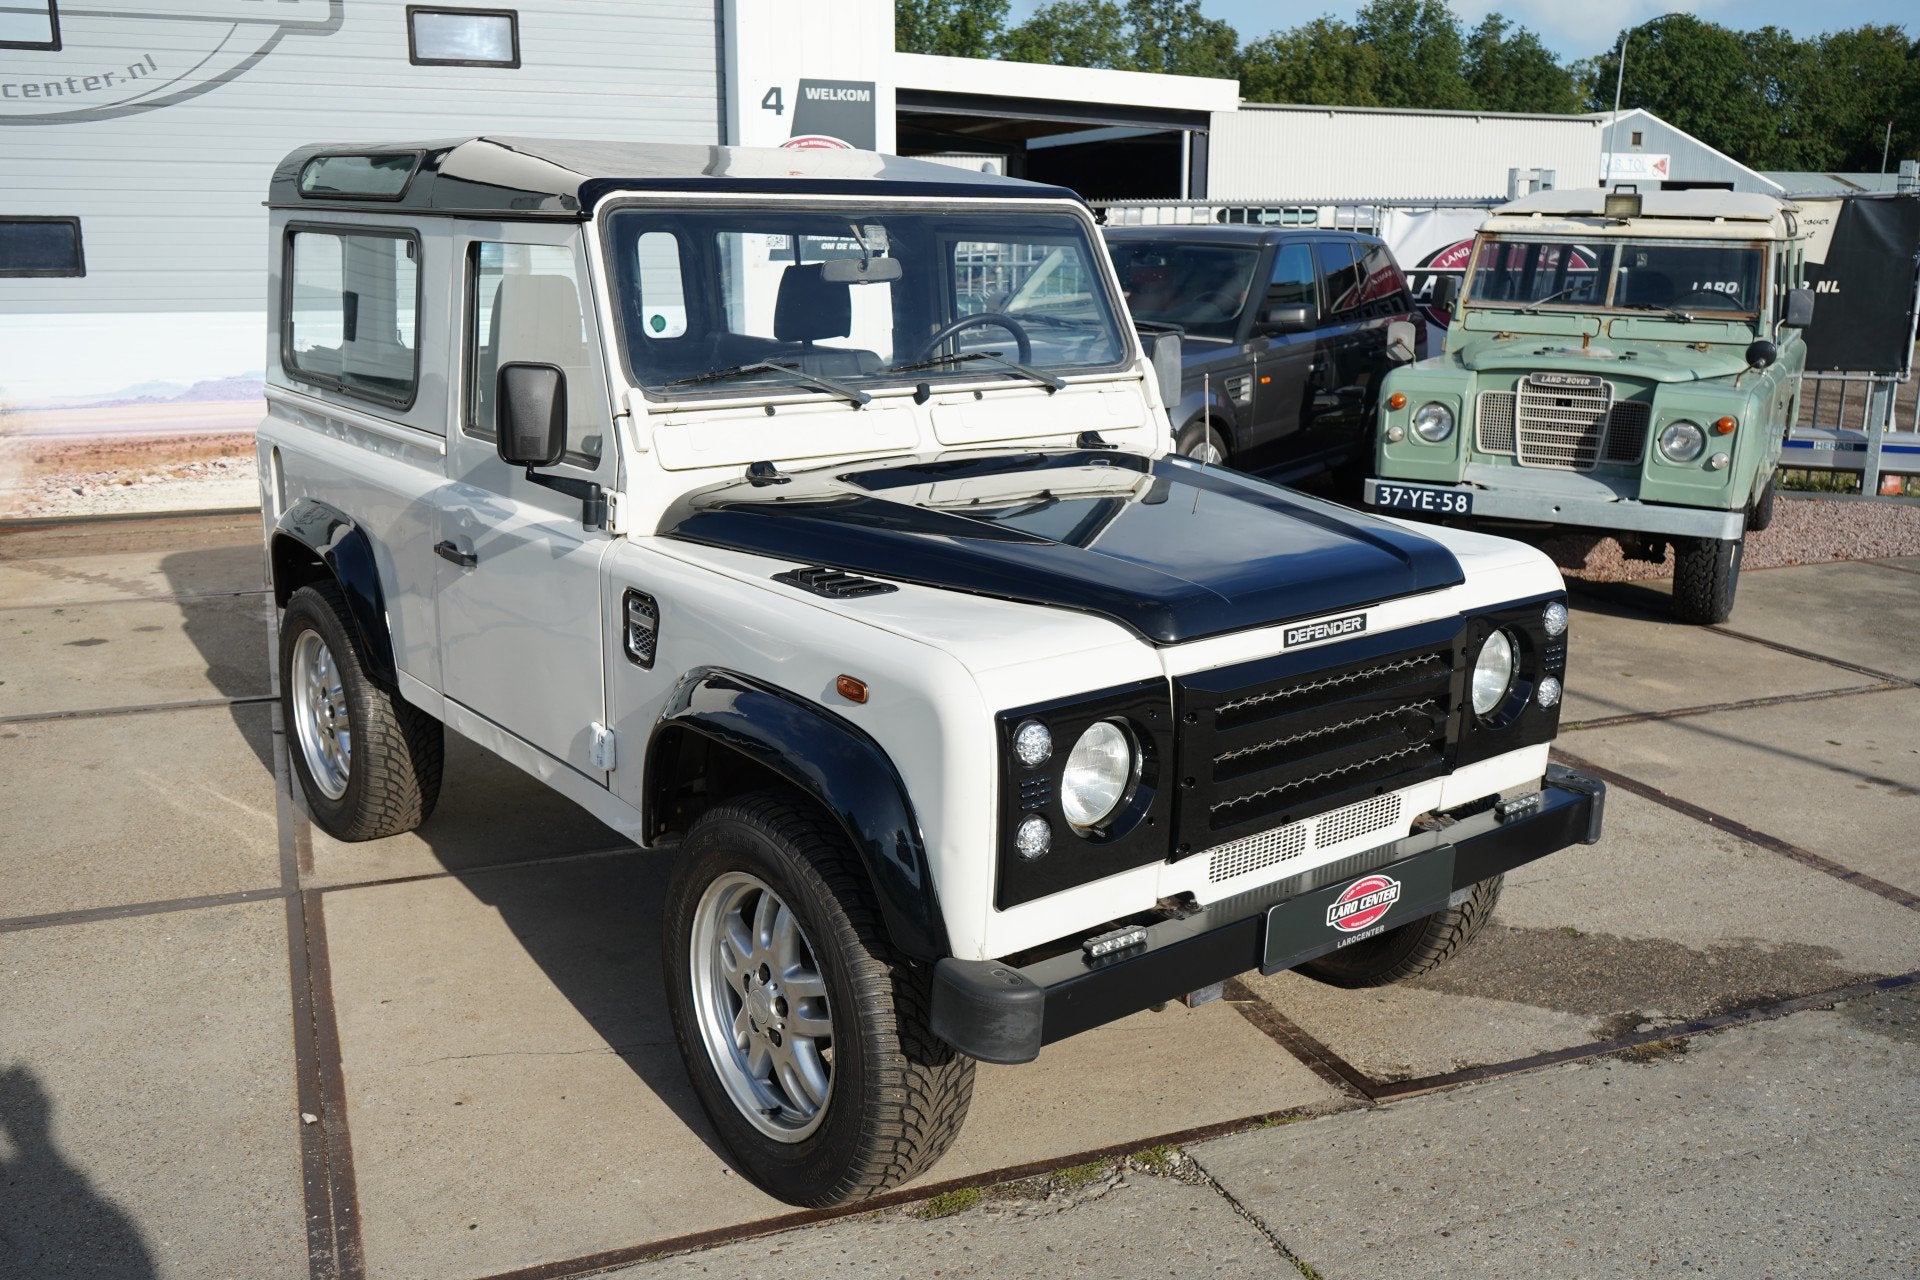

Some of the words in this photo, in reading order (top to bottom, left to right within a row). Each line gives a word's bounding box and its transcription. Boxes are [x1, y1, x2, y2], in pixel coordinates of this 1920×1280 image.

[2, 53, 157, 98] center.nl
[761, 86, 784, 116] 4
[805, 87, 870, 102] WELKOM
[821, 242, 836, 250] OM
[1540, 375, 1591, 386] LAND-ROVER
[1287, 616, 1363, 645] DEFENDER
[1331, 901, 1358, 920] LARO
[1360, 887, 1397, 909] CENTER
[1337, 925, 1385, 948] LAROCENTER
